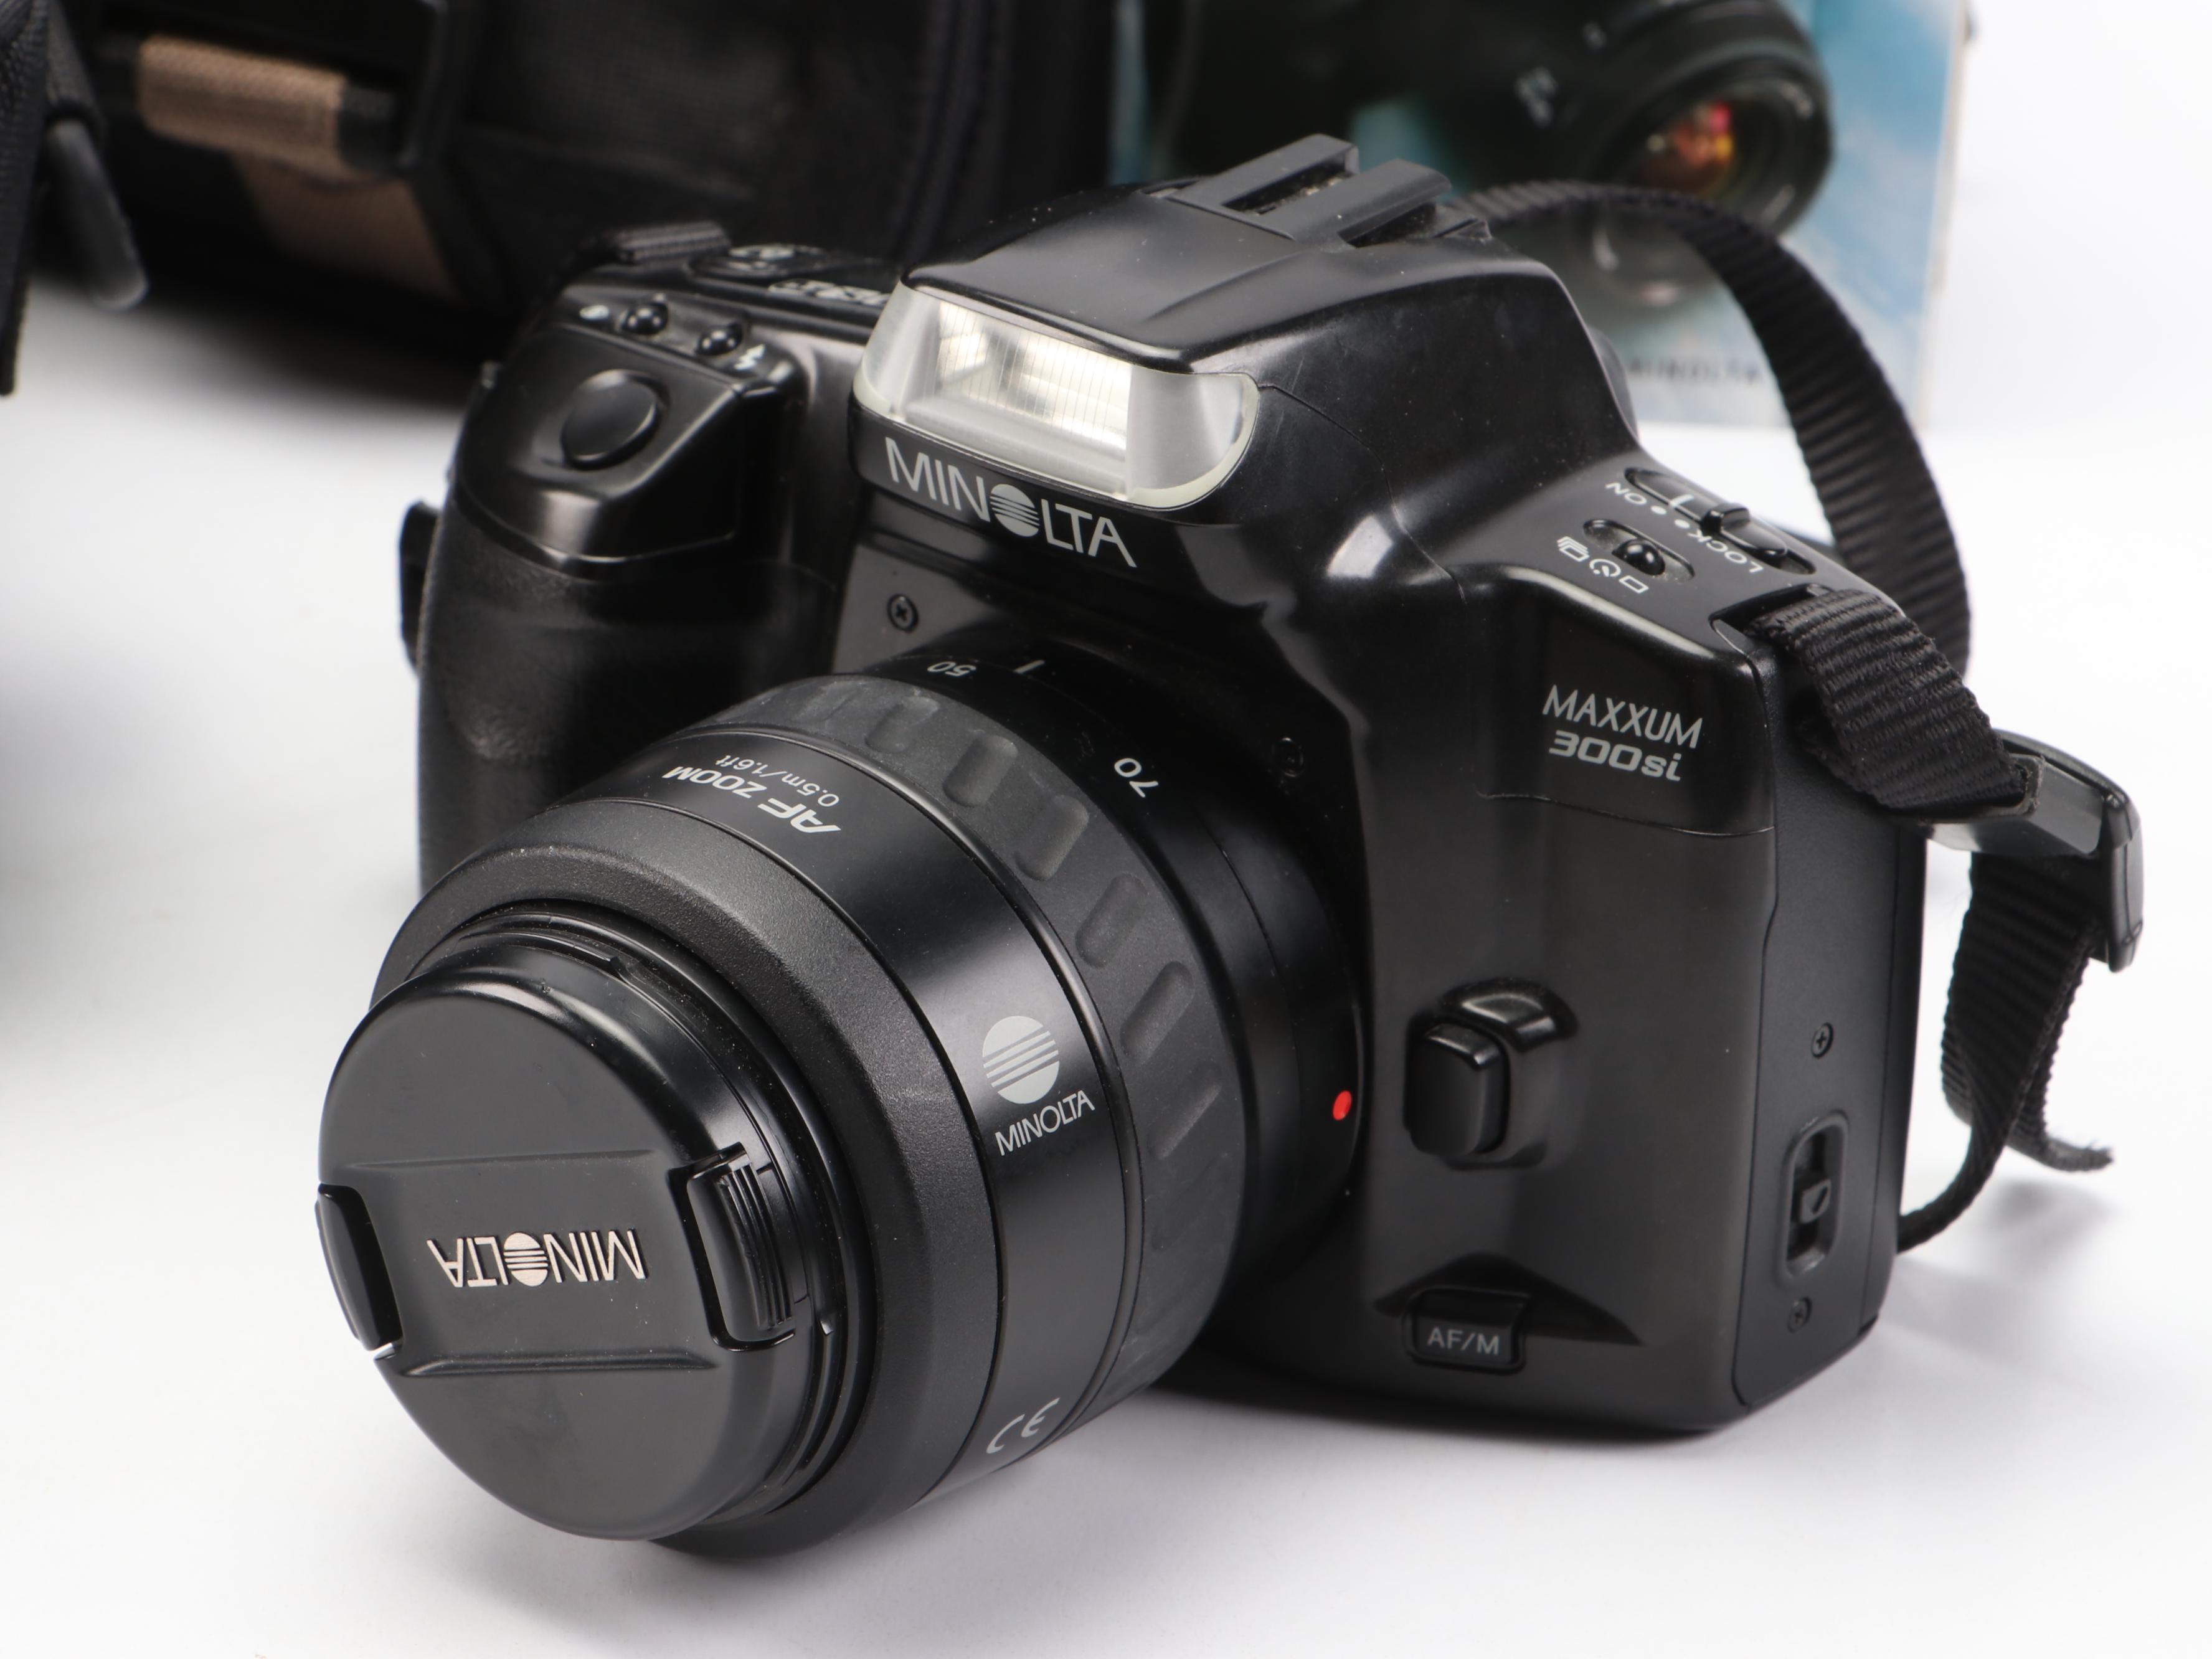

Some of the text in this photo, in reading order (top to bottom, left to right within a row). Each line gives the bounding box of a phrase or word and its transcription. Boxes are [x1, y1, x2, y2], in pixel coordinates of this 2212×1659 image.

[885, 436, 1137, 568] MINOLTA
[1605, 482, 1647, 505] ON
[1687, 529, 1764, 574] LOCK
[927, 661, 976, 677] 50
[1542, 684, 1703, 749] MAXXUM
[715, 755, 839, 807] 0.5m/1.6ft
[1114, 758, 1159, 798] 70
[1549, 730, 1682, 782] 300si
[661, 766, 841, 833] AF ZOOM
[995, 1090, 1095, 1156] MINOLTA
[427, 1229, 646, 1288] MINOLTA
[1427, 1326, 1500, 1355] AF/M
[986, 1397, 1060, 1454] CE
